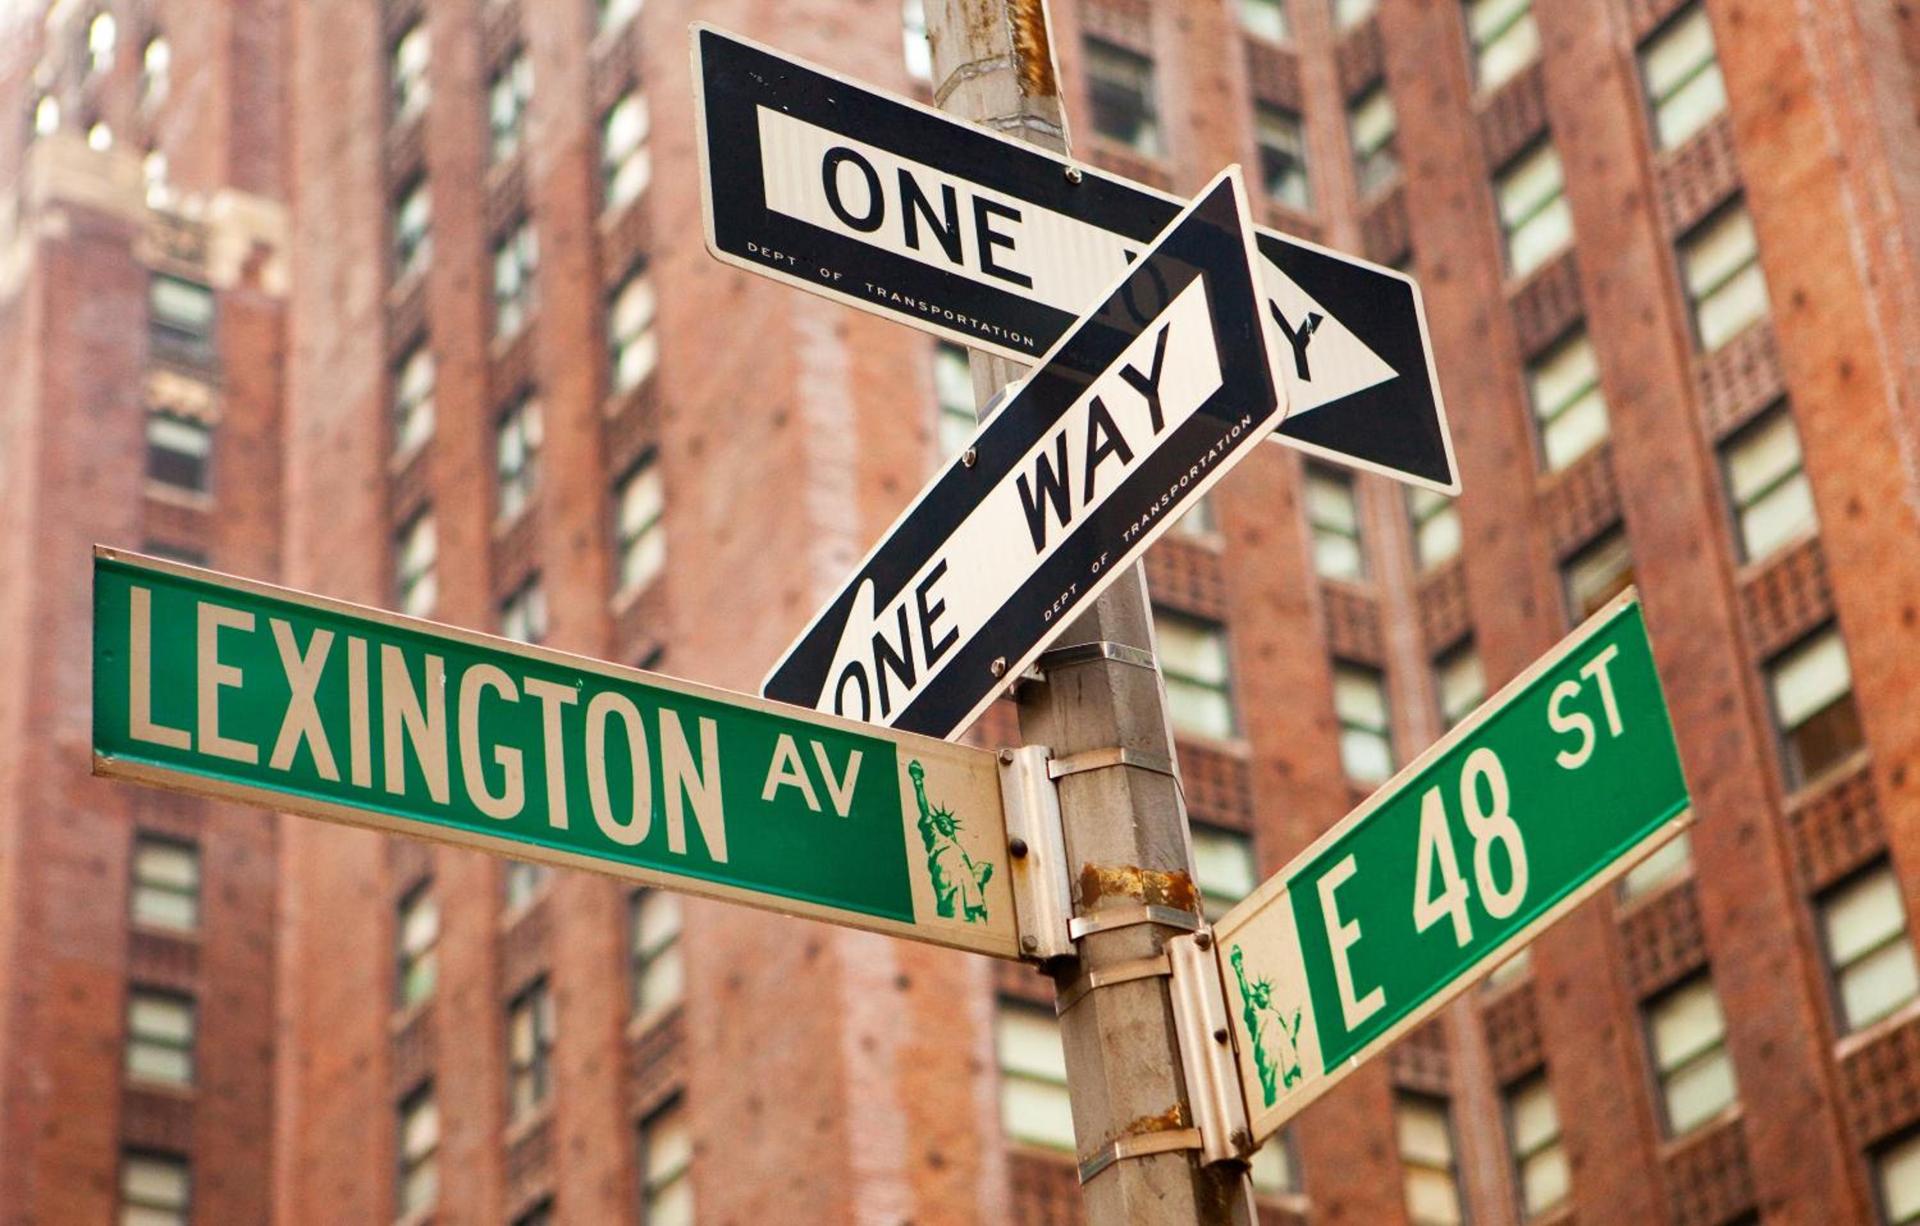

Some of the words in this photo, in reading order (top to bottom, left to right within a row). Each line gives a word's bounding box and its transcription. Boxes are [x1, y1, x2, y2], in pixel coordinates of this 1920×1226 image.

[747, 242, 796, 266] DEPT
[819, 267, 843, 281] OF
[865, 283, 1034, 348] TRANSPORTATION
[822, 147, 1033, 289] ONE
[834, 558, 960, 723] ONE
[1015, 322, 1170, 555] WAY
[1044, 583, 1077, 621] DEPT
[1091, 552, 1108, 573] OF
[1123, 414, 1252, 542] TRANSPORTATION
[129, 586, 728, 864] LEXINGTON
[761, 734, 863, 818] AV
[1316, 853, 1387, 1032] E
[1412, 747, 1528, 949] 48
[1547, 643, 1624, 770] ST
